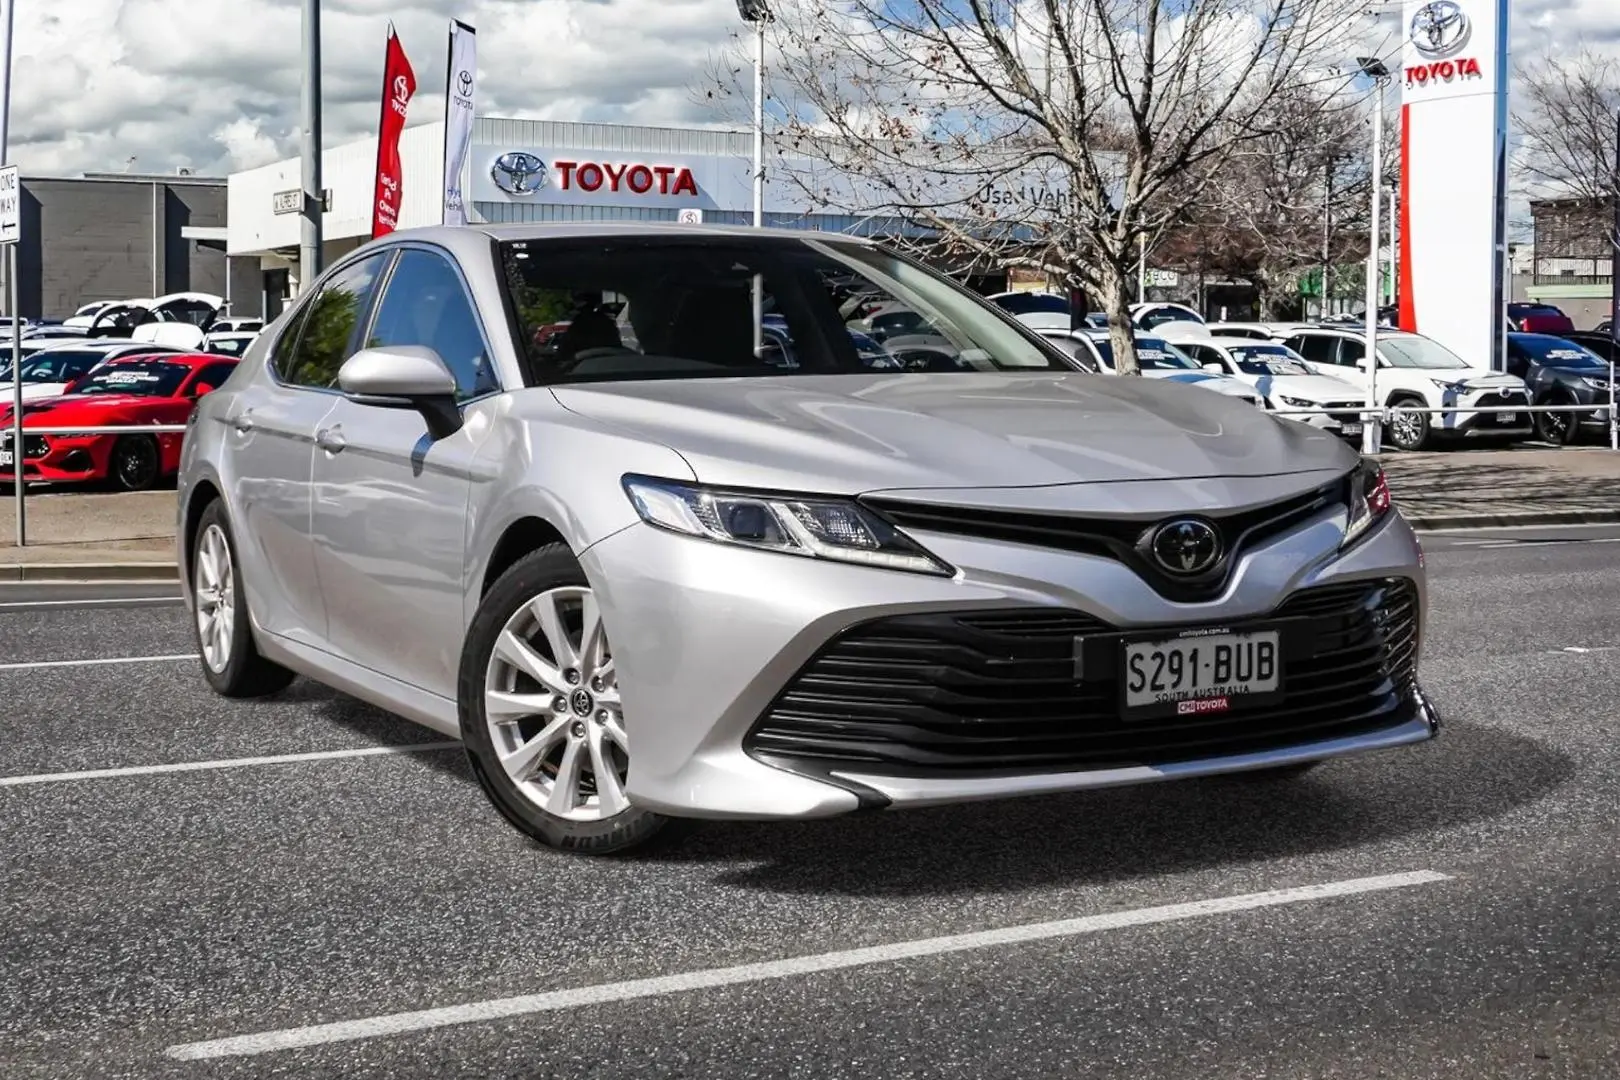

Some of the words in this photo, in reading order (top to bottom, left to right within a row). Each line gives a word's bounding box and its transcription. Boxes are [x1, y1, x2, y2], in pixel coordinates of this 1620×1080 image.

[1404, 57, 1481, 83] TOYOTA
[454, 96, 474, 110] TOYOTA
[0, 173, 15, 191] ONE
[555, 161, 698, 196] TOYOTA
[0, 196, 16, 214] WAY
[1155, 691, 1189, 703] SOUTH
[1194, 684, 1250, 698] AUSTRALIA
[1196, 699, 1228, 711] TOYOTA
